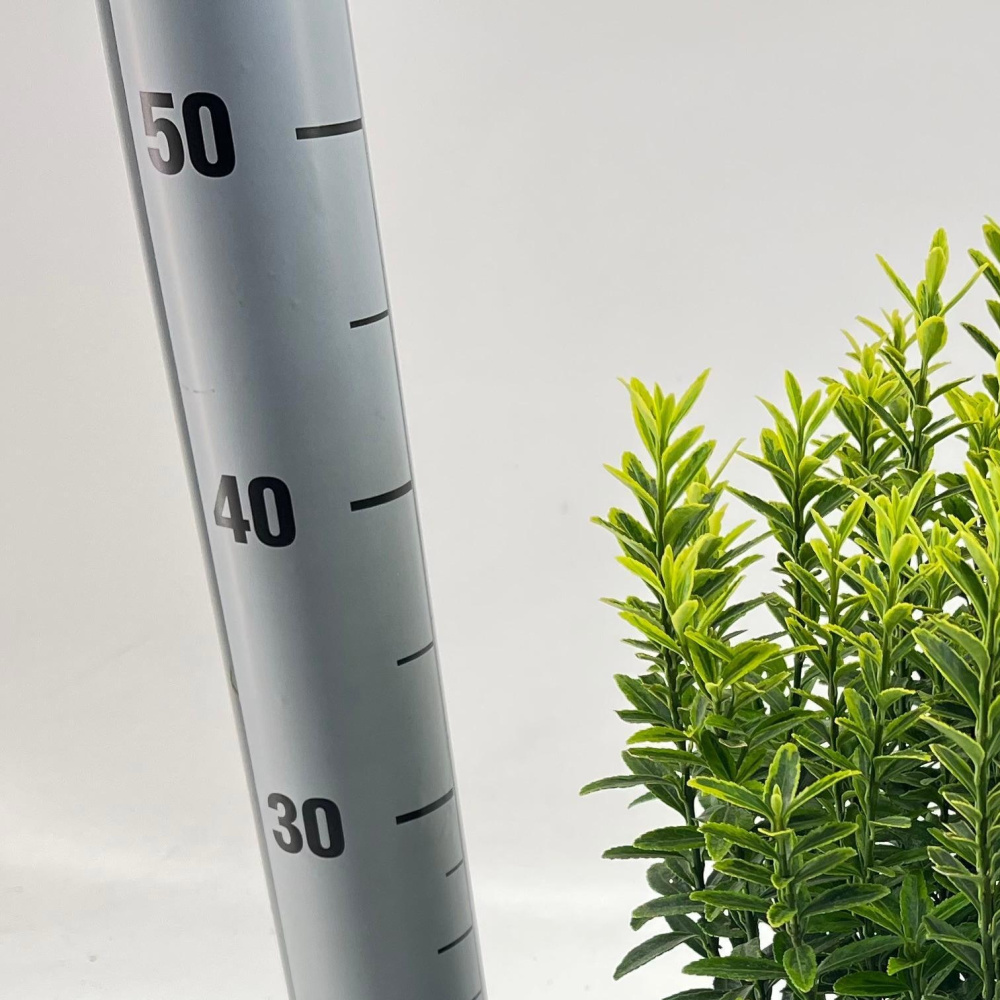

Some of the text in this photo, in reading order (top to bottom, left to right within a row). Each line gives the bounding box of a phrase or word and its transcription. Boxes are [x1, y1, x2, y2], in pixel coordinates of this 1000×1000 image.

[140, 91, 236, 178] 50
[213, 474, 297, 548] 40
[267, 792, 345, 859] 30
